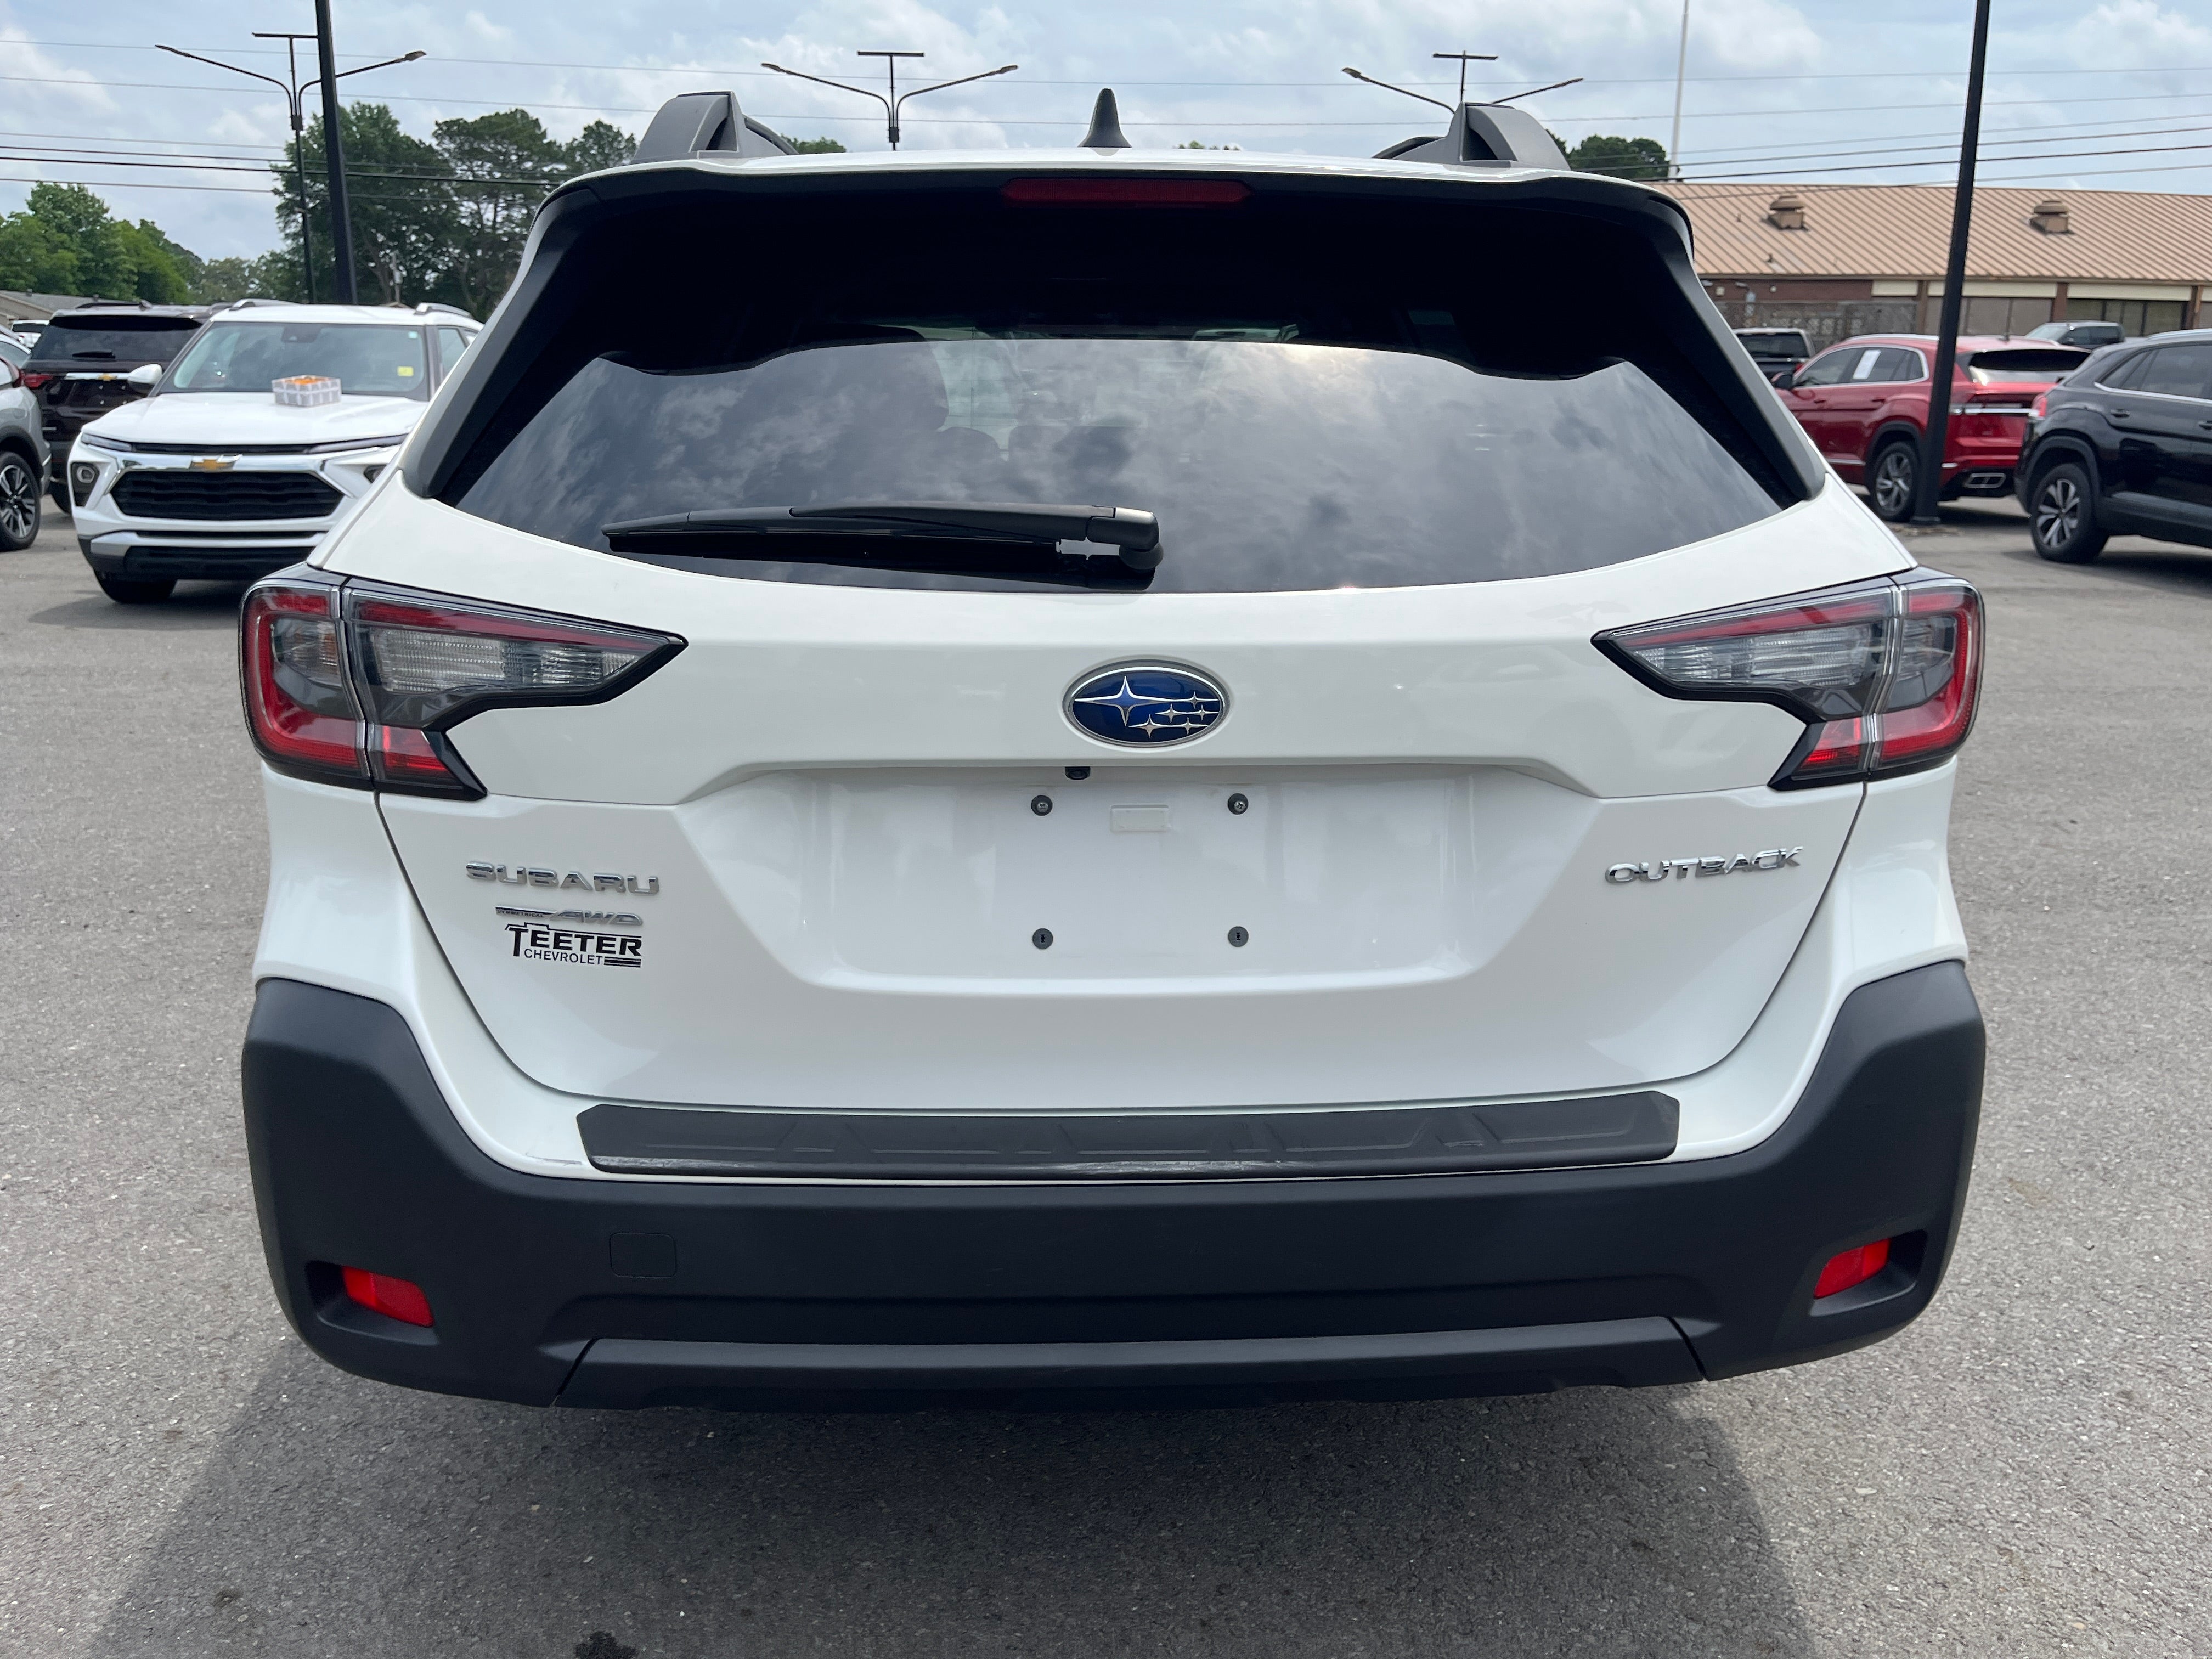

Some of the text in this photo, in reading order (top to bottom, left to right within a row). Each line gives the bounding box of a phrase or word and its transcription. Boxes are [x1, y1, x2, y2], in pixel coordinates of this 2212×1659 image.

[466, 861, 659, 895] SUBARU
[1605, 846, 1803, 883] OUTBACK
[550, 909, 644, 926] AWD
[508, 927, 642, 957] TEETER
[524, 948, 603, 966] CHEVROLET
